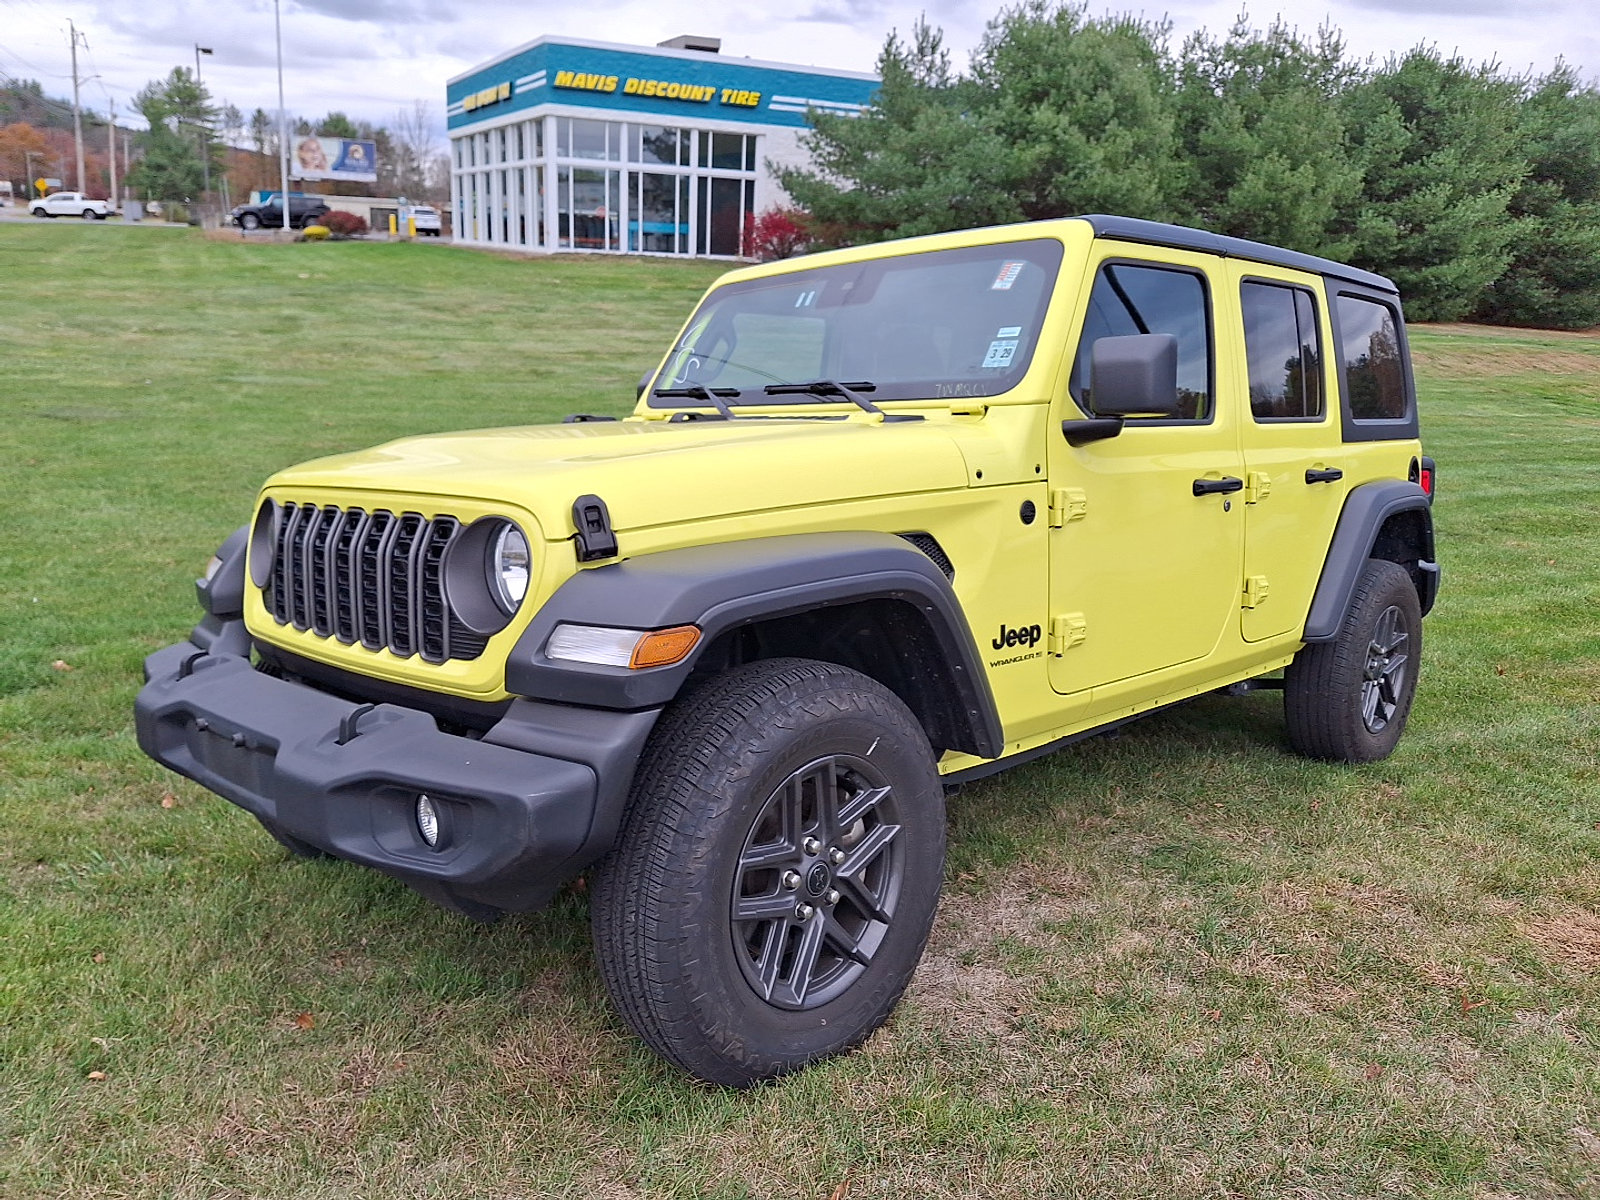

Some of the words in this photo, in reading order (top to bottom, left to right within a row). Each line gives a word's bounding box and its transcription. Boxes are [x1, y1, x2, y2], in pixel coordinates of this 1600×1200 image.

[554, 70, 619, 93] MAVIS
[623, 77, 716, 102] DISCOUNT
[719, 88, 762, 107] TIRE
[990, 348, 998, 359] 3
[992, 624, 1041, 650] Jeep
[989, 653, 1035, 668] WRANGLER
